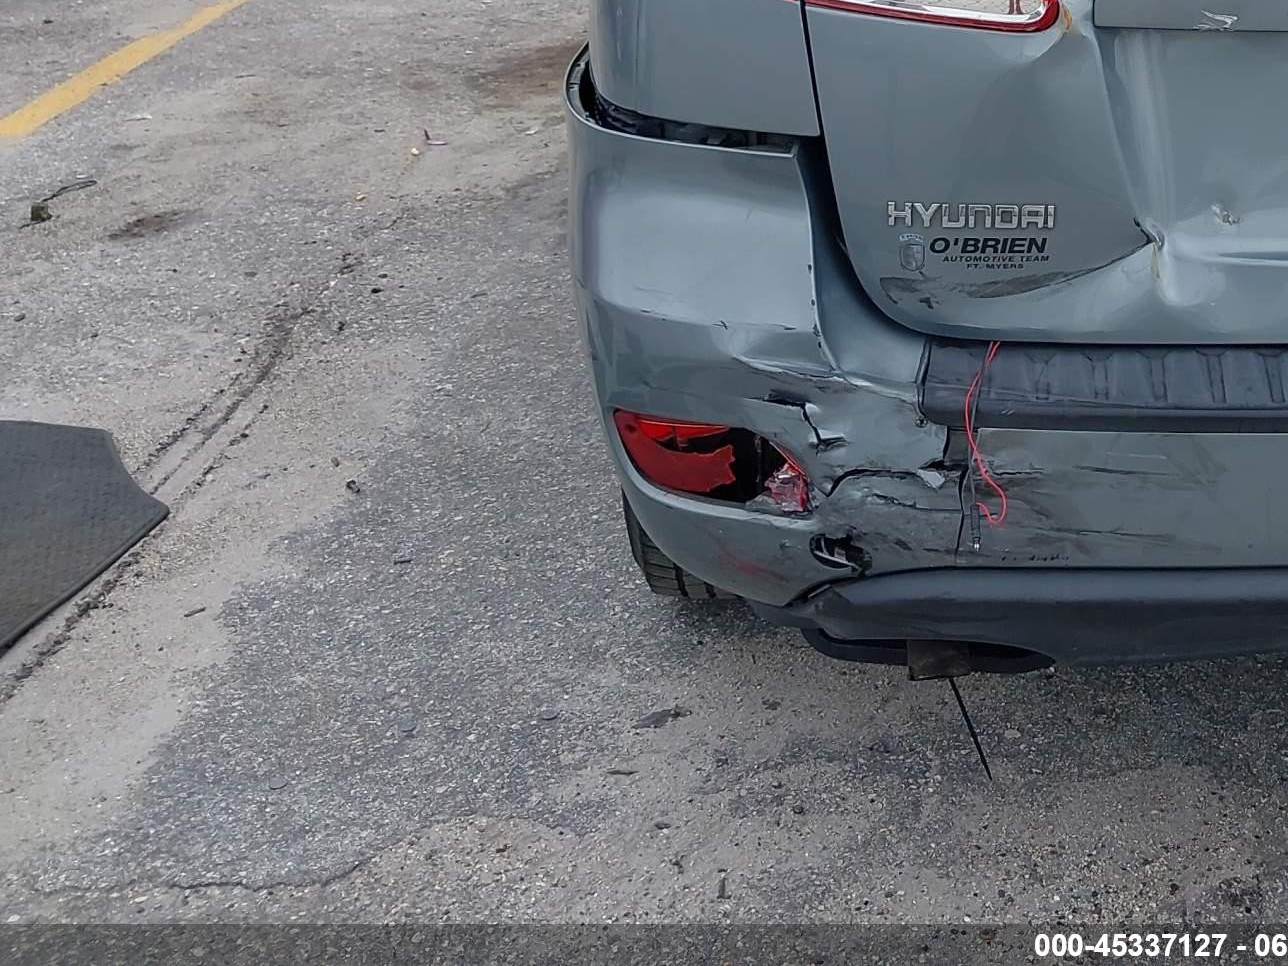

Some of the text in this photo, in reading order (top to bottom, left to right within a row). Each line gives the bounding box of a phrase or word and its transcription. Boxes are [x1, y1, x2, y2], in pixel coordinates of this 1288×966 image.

[887, 201, 1056, 229] HYUNDAI
[929, 237, 1047, 254] O'BRIEN
[942, 255, 1049, 263] AUTOMOTIVE TEAM
